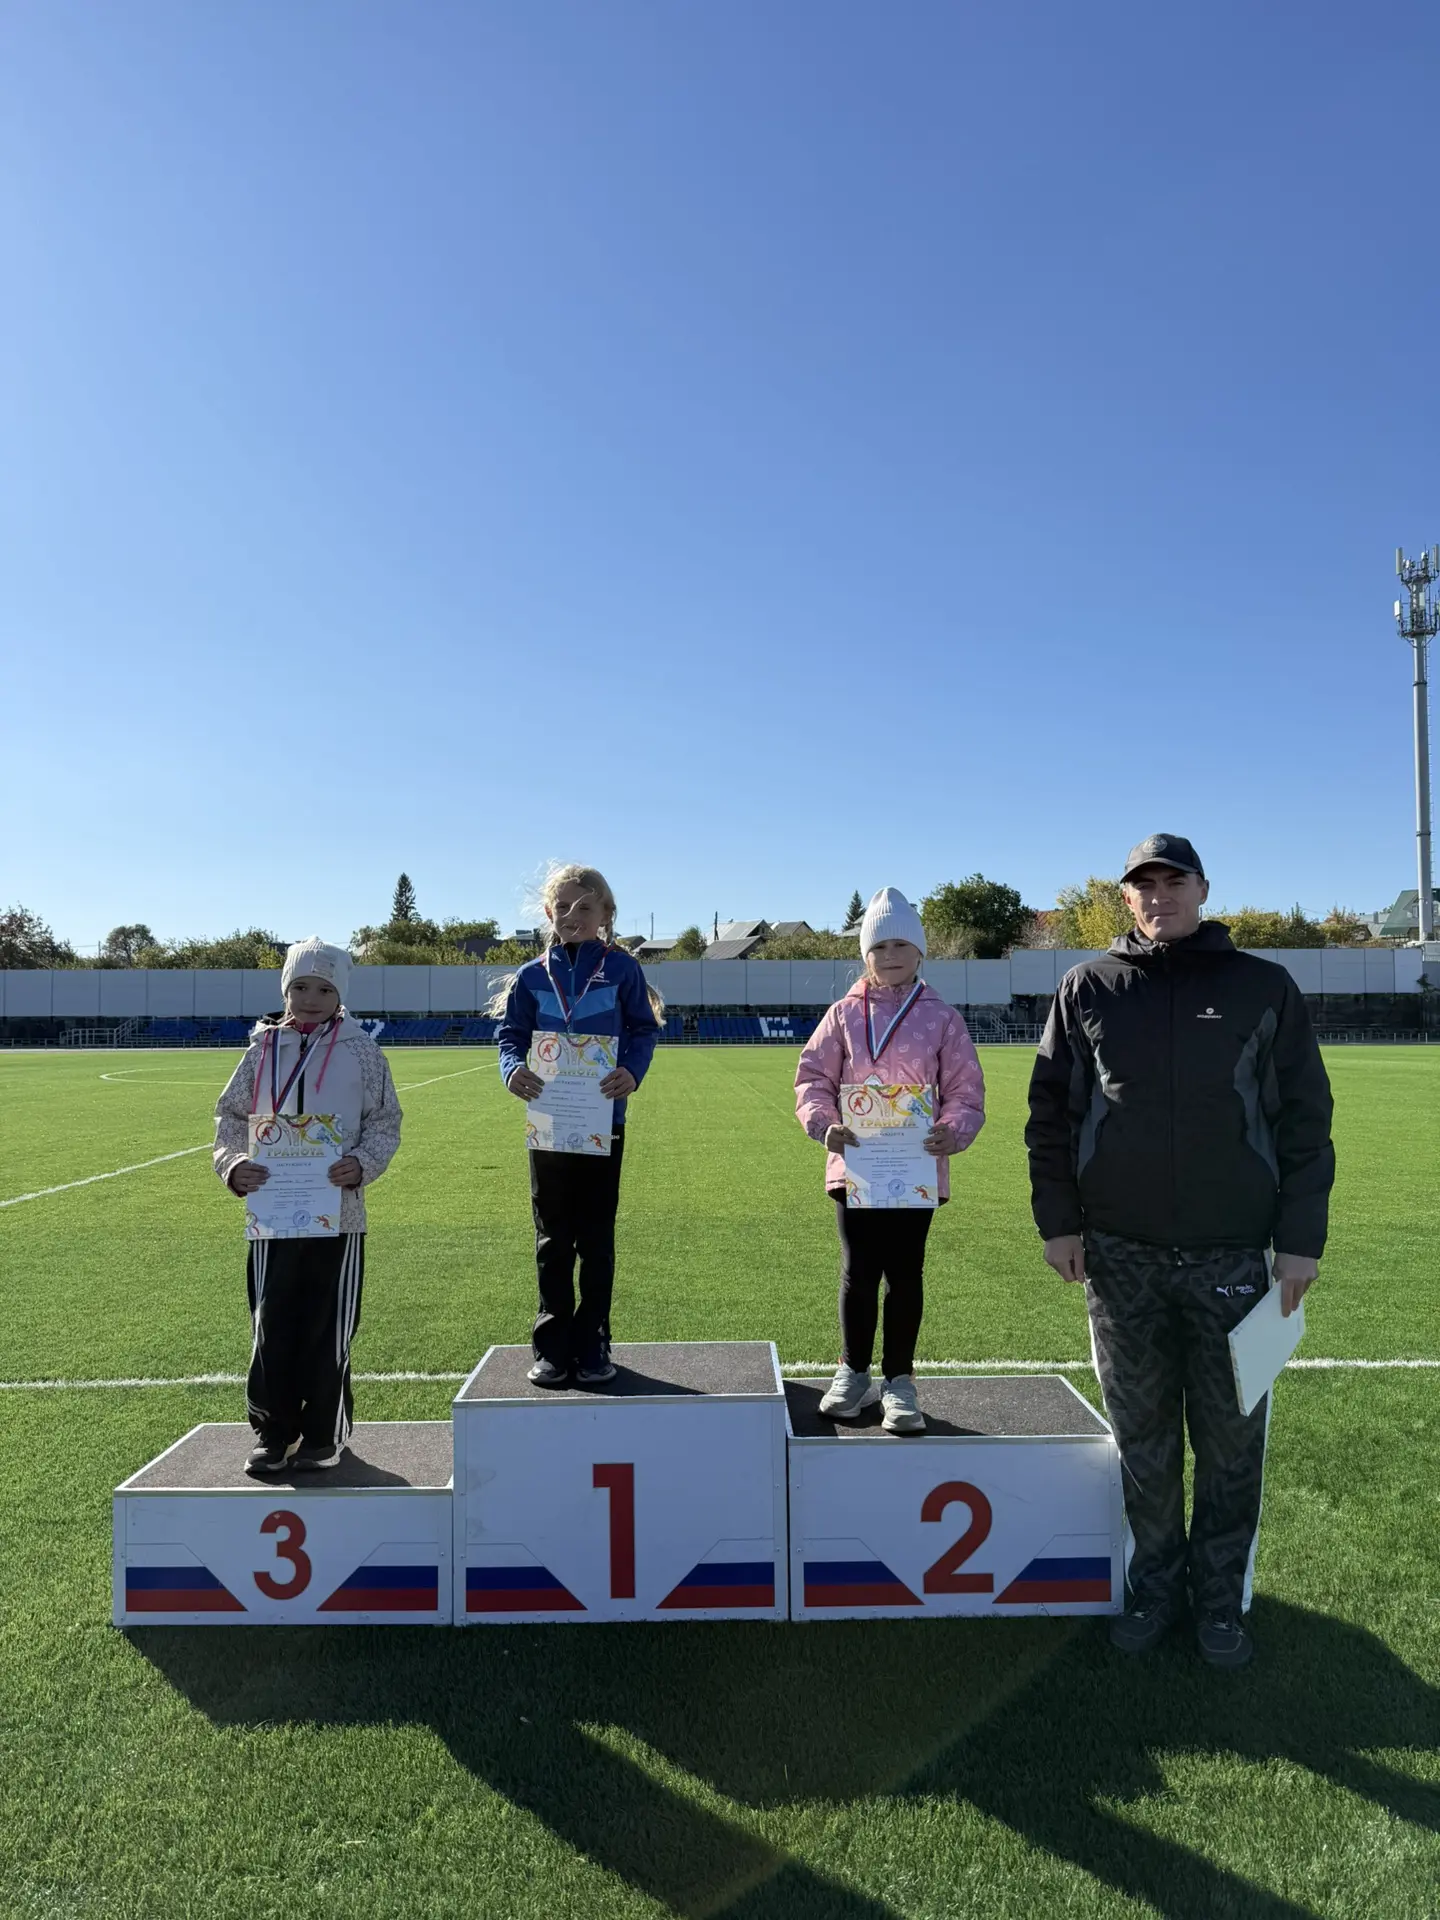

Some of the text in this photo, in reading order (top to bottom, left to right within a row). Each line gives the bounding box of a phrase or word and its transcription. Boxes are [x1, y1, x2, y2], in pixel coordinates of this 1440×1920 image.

[252, 1509, 313, 1601] 3
[593, 1463, 636, 1599] 1
[920, 1480, 995, 1595] 2
